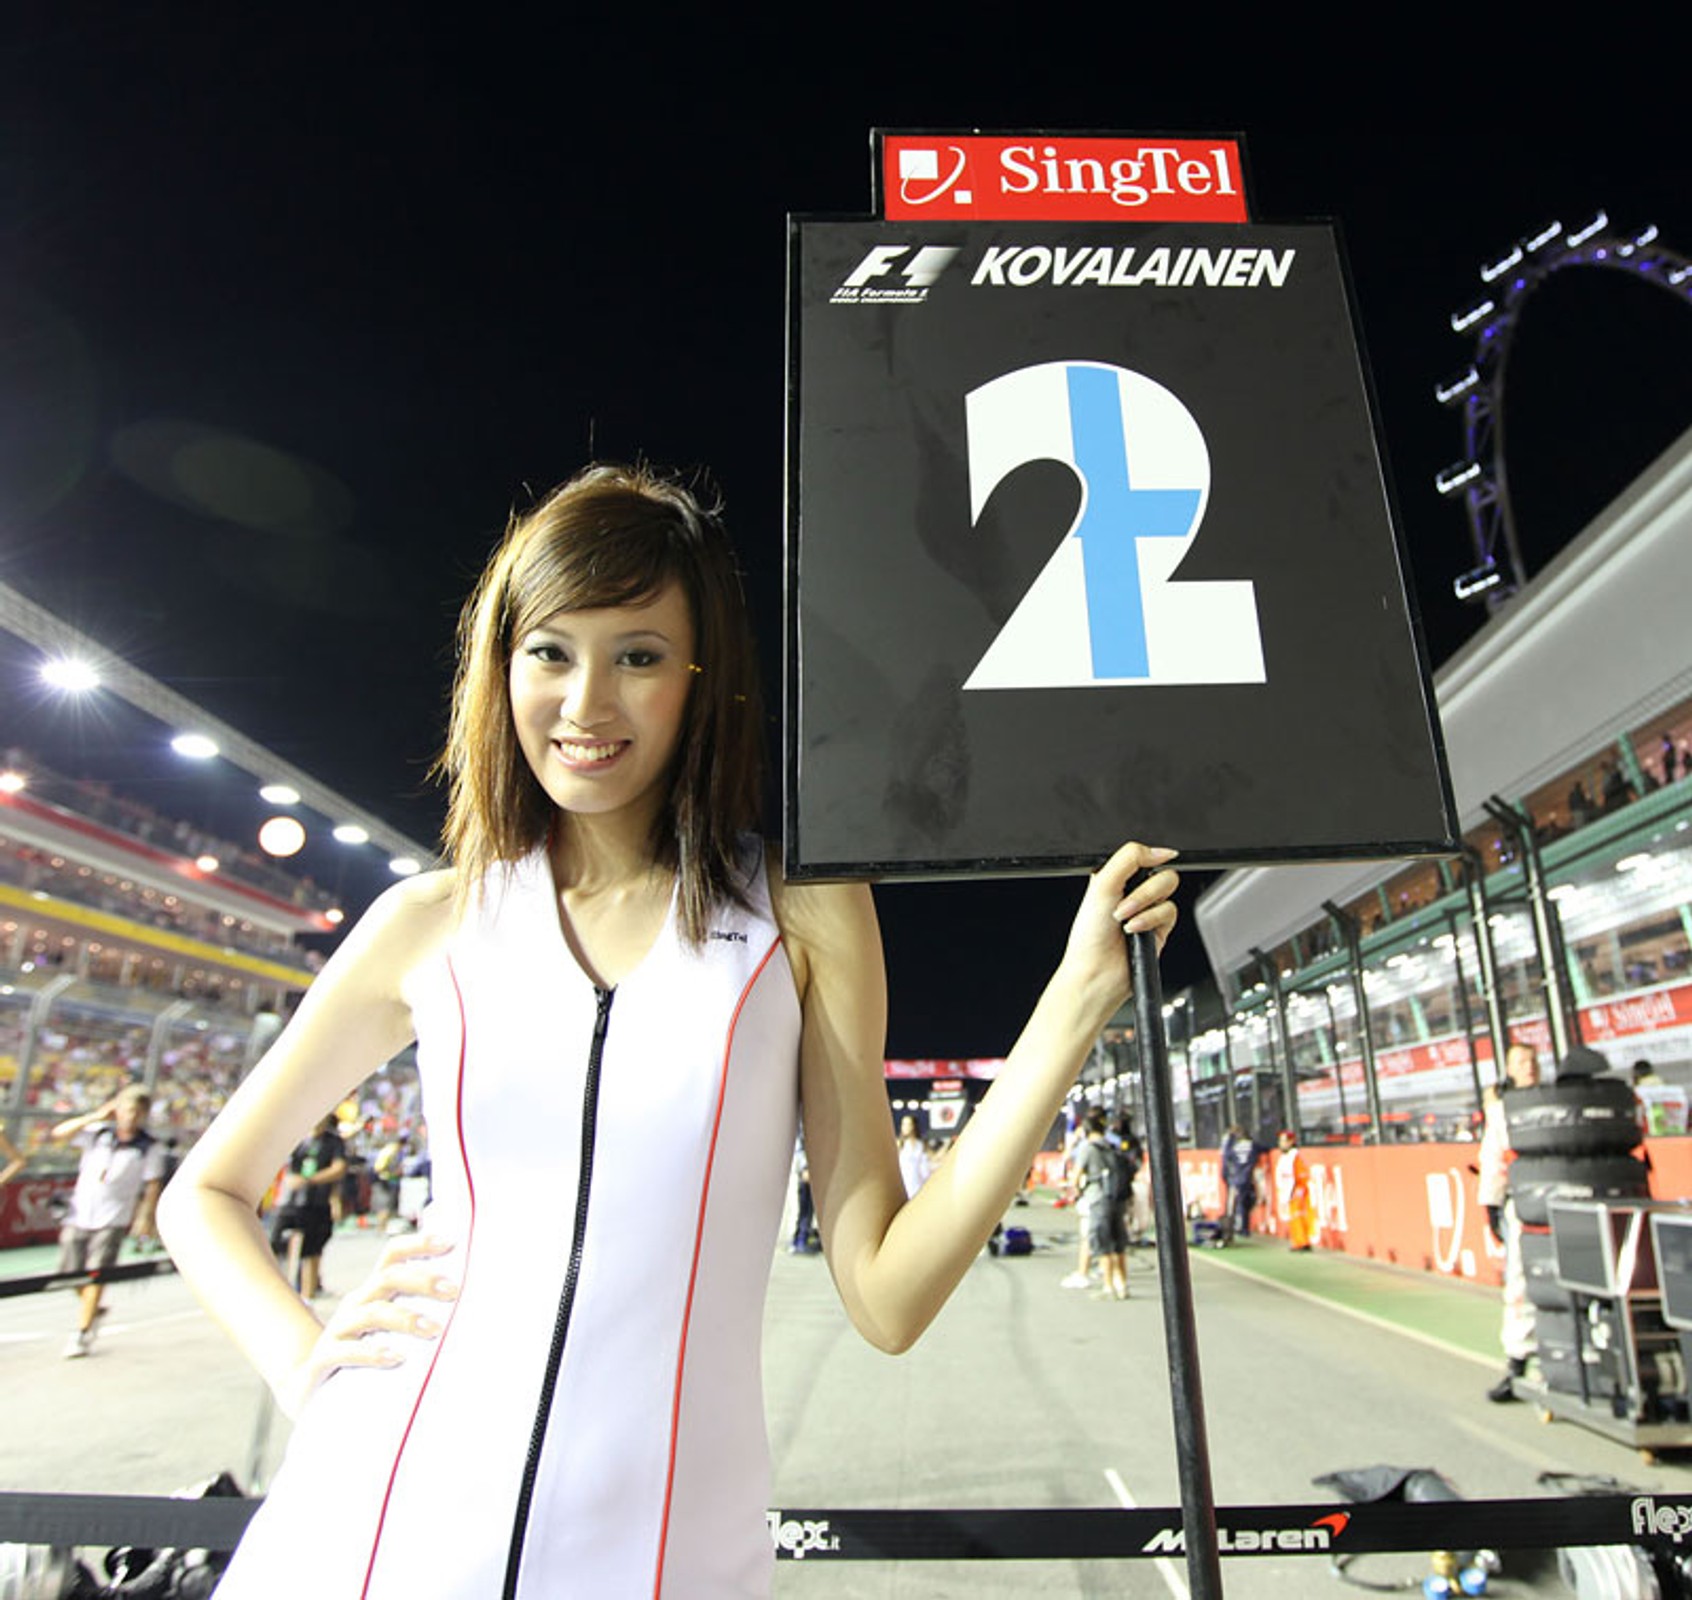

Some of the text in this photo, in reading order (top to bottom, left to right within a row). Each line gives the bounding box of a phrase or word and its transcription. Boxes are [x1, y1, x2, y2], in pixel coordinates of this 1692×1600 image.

[1000, 146, 1236, 206] SingTel
[842, 245, 960, 287] F1
[970, 247, 1295, 287] KOVALAINEN
[833, 287, 860, 298] FIA
[860, 287, 918, 298] Formula
[961, 360, 1267, 689] 2
